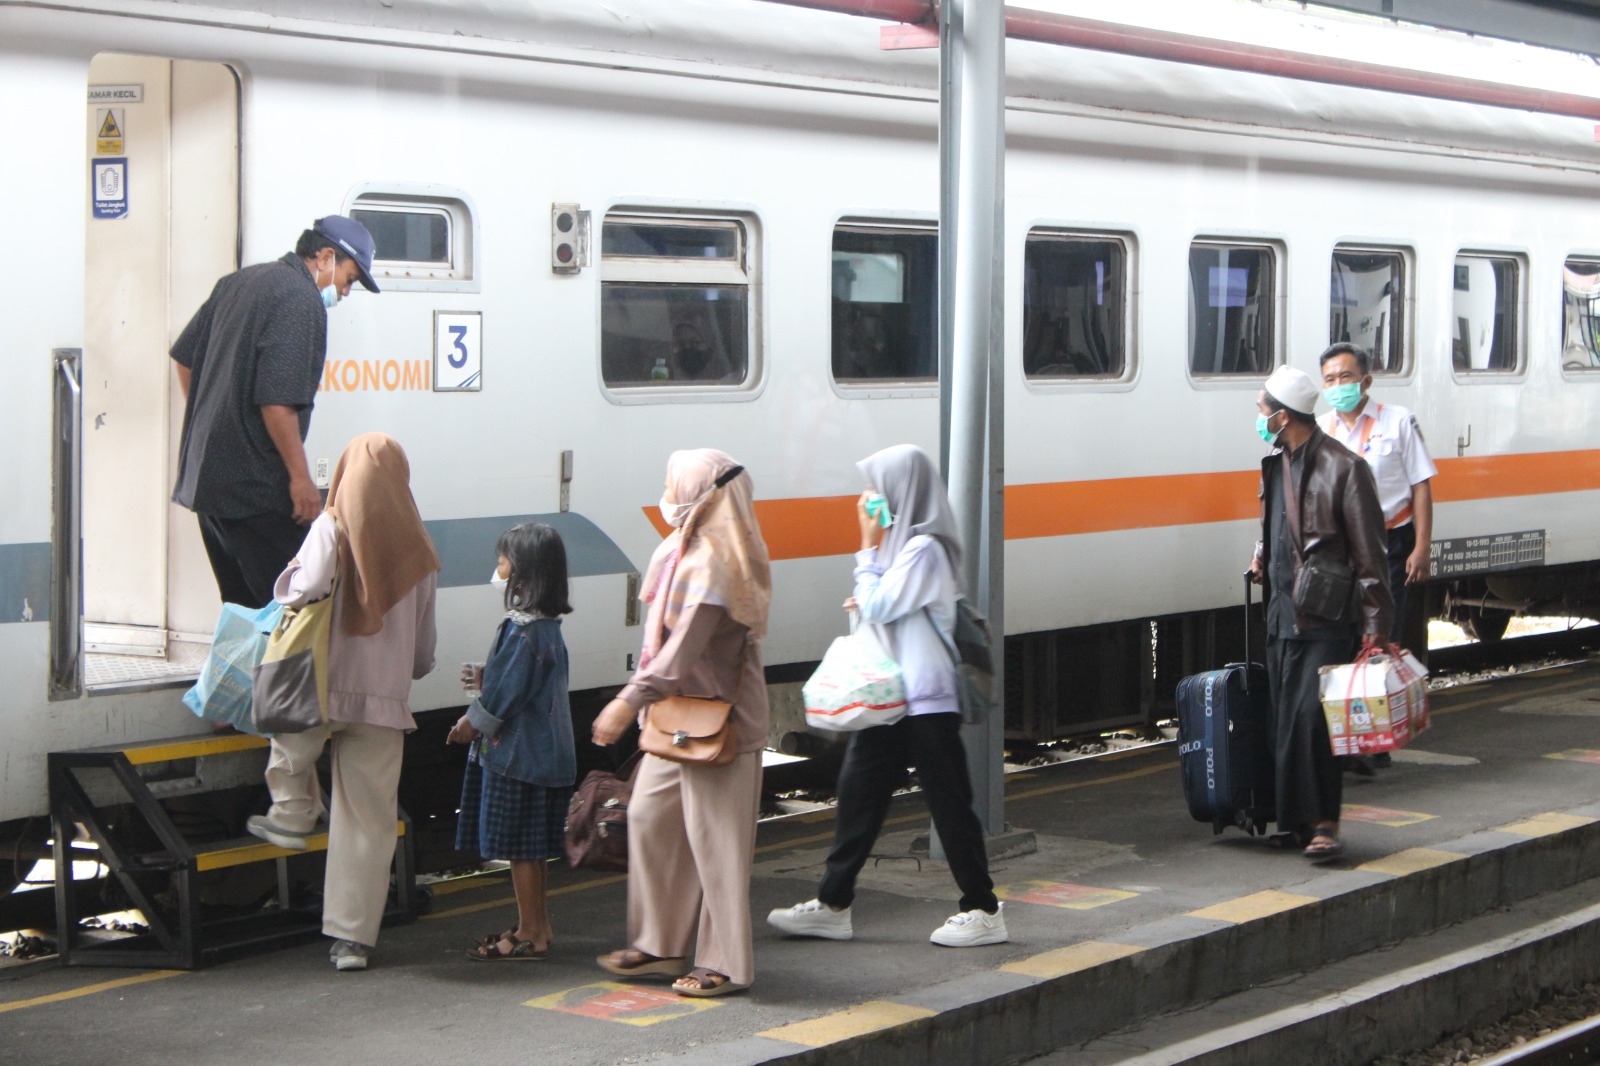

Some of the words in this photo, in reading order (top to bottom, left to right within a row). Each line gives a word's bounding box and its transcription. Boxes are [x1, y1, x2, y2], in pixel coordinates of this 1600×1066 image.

[113, 90, 136, 98] KECIL
[447, 325, 468, 369] 3
[317, 359, 430, 392] KONOMI
[1205, 677, 1213, 717] POLO
[1206, 747, 1215, 789] POLO
